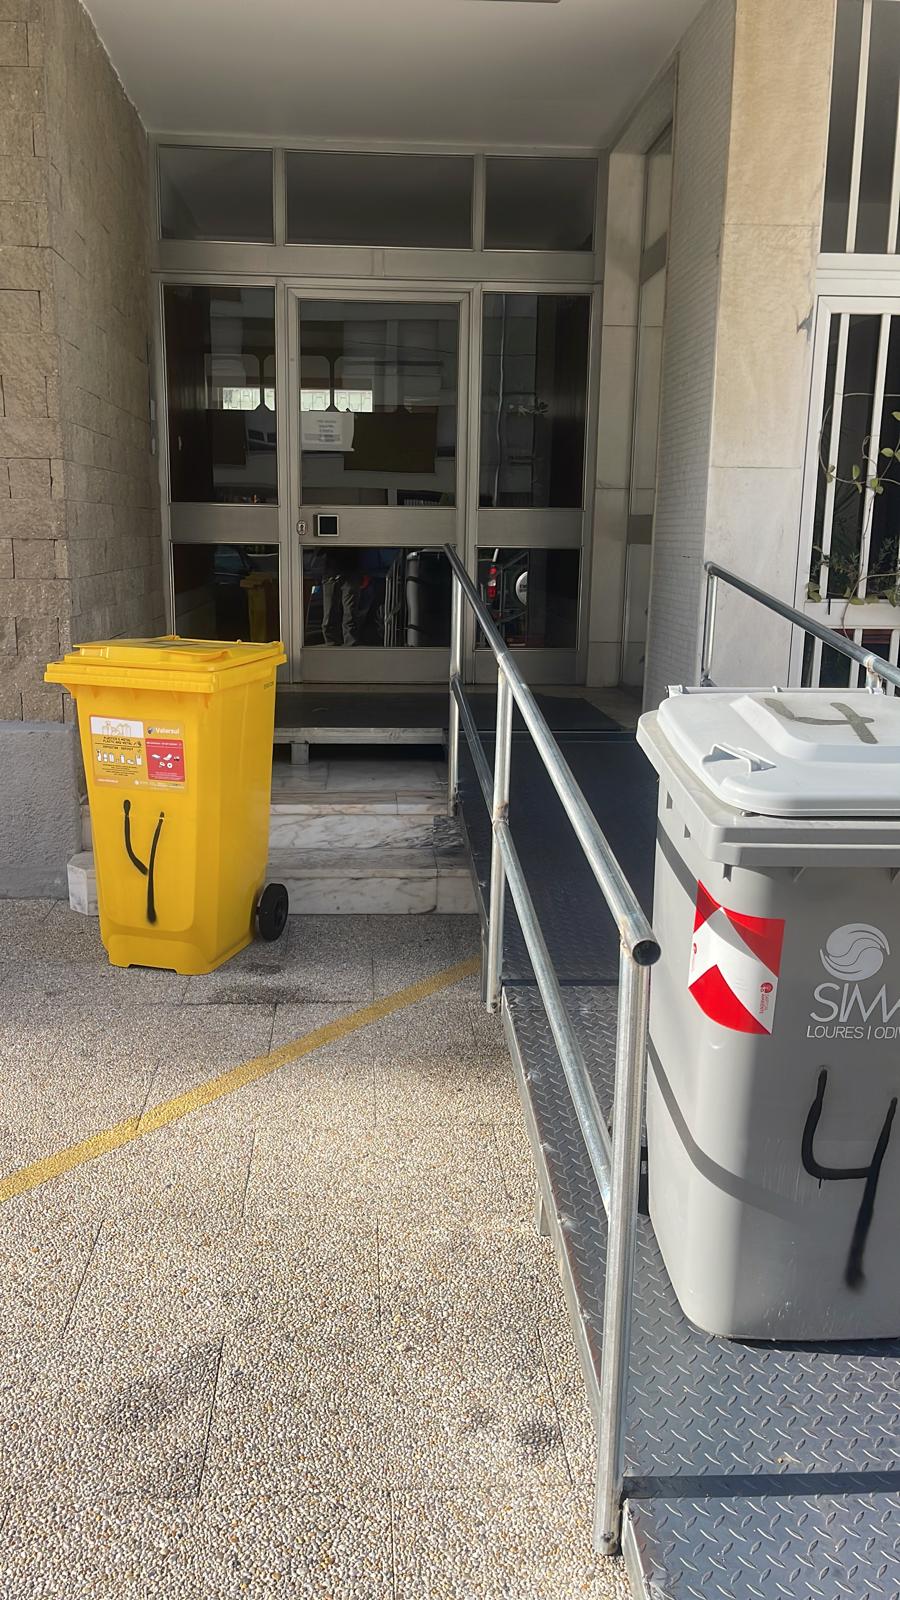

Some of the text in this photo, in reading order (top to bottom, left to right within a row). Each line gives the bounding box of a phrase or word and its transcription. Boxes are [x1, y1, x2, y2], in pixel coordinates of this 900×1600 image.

[764, 697, 879, 744] 4
[806, 1026, 865, 1039] LOURES
[802, 1066, 899, 1290] 4
